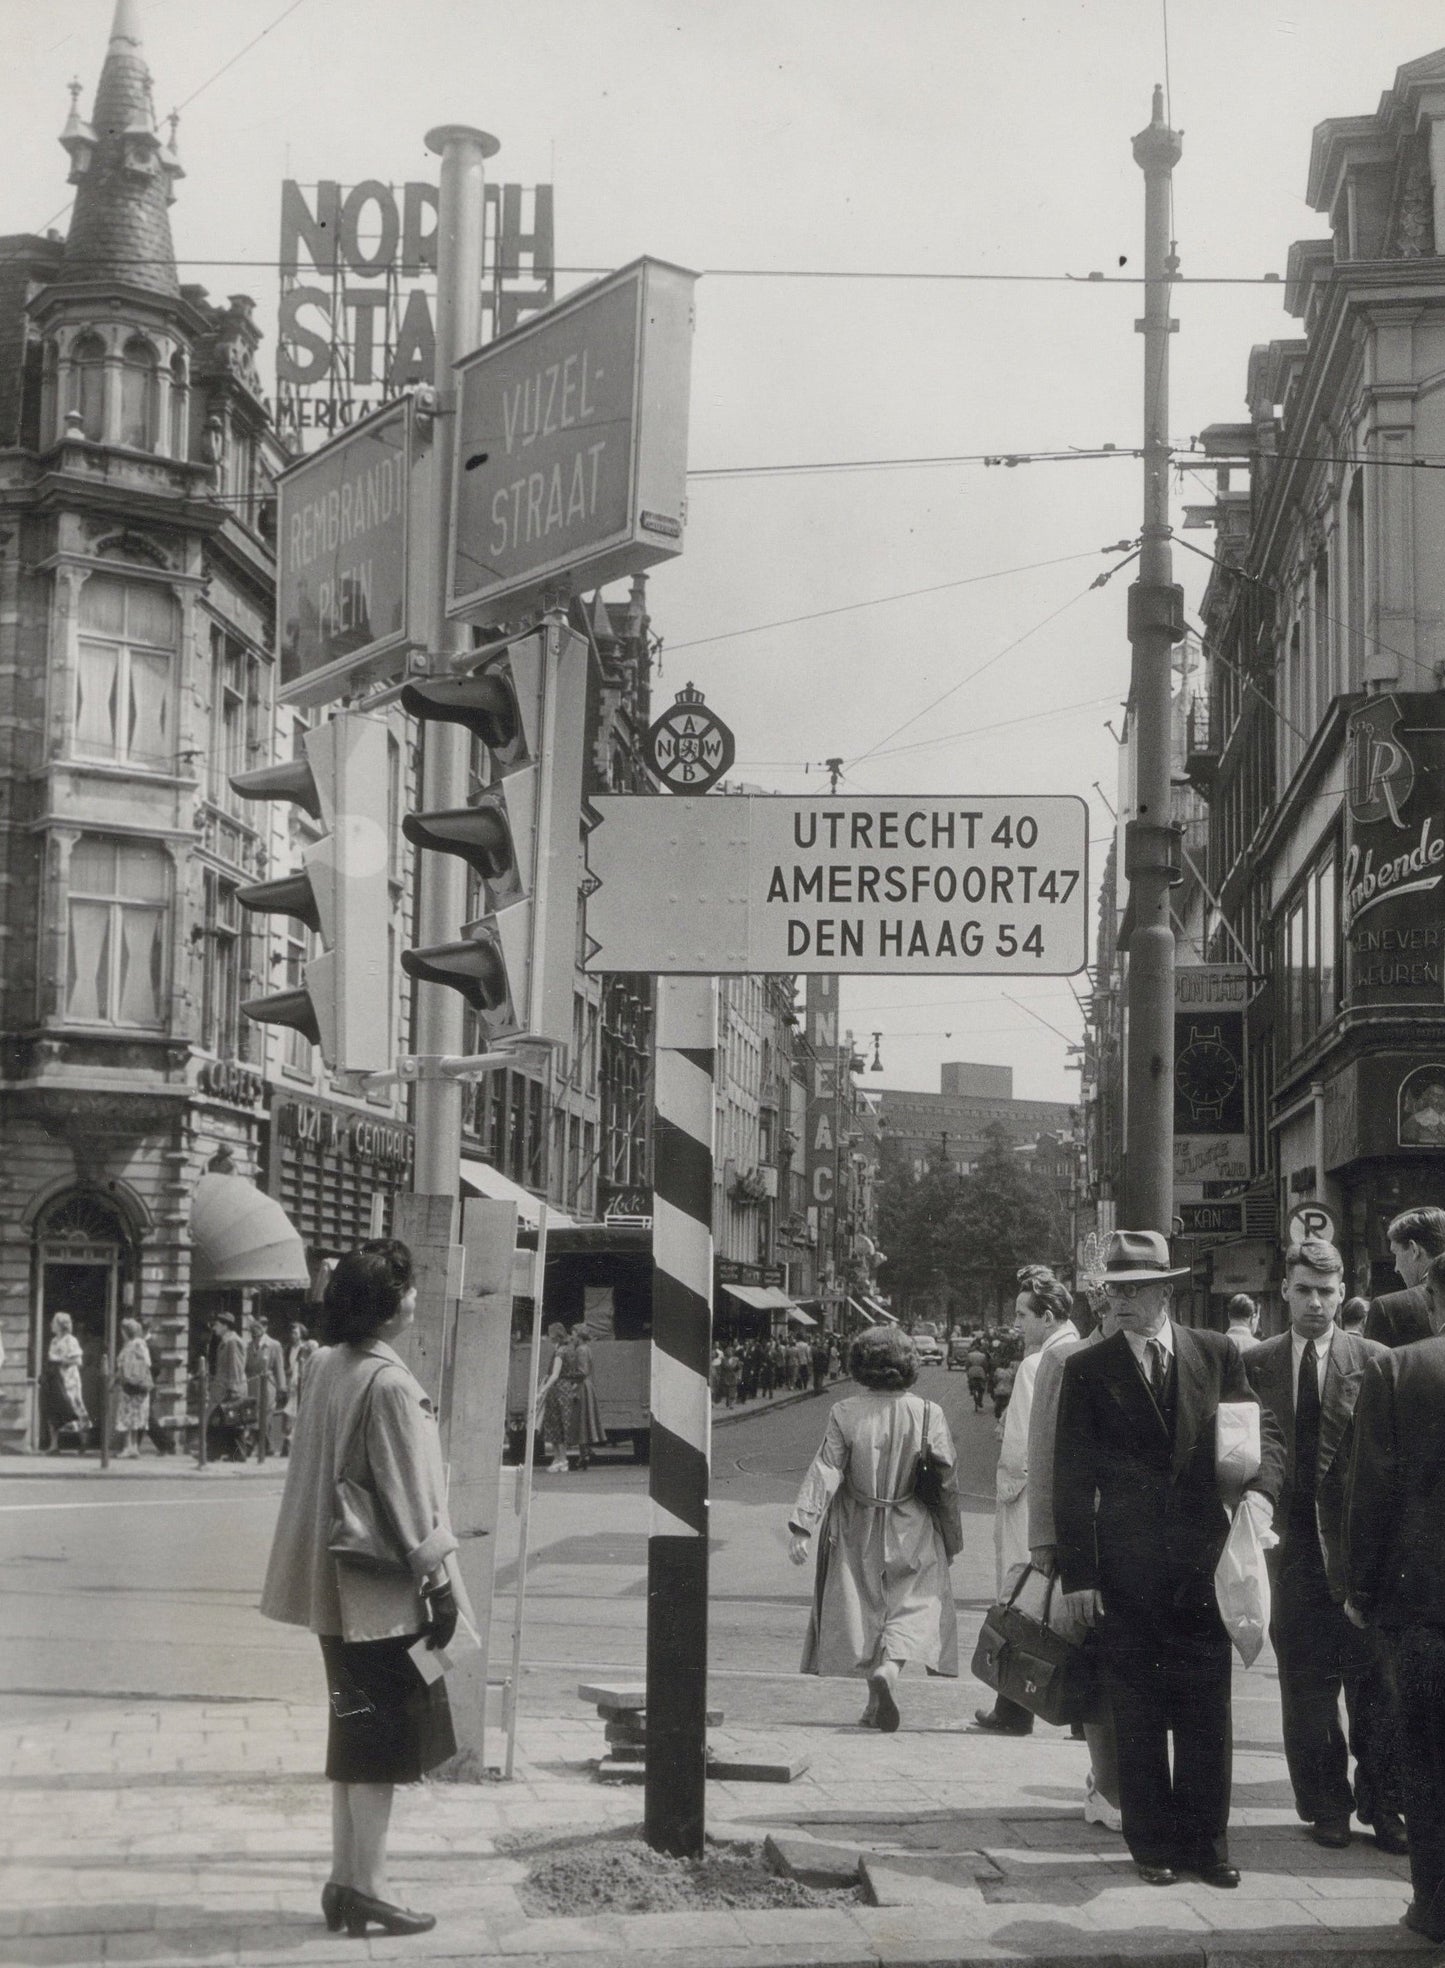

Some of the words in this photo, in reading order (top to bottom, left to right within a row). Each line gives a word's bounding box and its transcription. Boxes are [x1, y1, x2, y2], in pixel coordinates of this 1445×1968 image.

[489, 441, 606, 557] STRAAT
[319, 558, 373, 645] PLEIN
[795, 812, 983, 849] UTRECHT
[990, 815, 1038, 849] 40
[767, 865, 1038, 904] AMERSFOORT
[1038, 870, 1080, 904] 47
[788, 919, 864, 957] DEN
[880, 919, 984, 957] HAAG
[996, 924, 1045, 958] 54
[813, 975, 835, 1201] INEAC
[355, 1121, 414, 1165] CENTRALE
